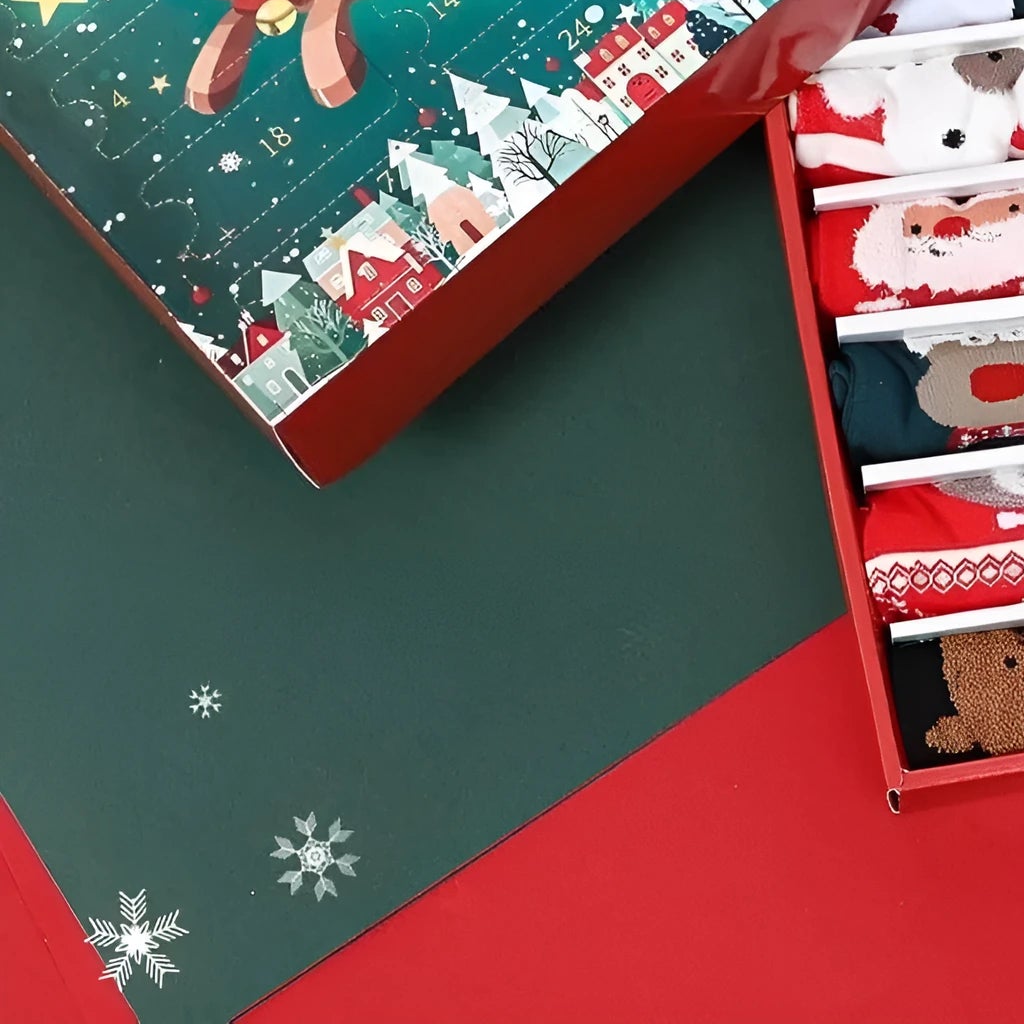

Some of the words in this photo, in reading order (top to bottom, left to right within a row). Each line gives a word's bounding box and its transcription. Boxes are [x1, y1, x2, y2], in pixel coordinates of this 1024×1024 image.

[557, 18, 593, 51] 24
[112, 89, 131, 108] 4
[259, 126, 292, 158] 18
[376, 170, 394, 193] 7
